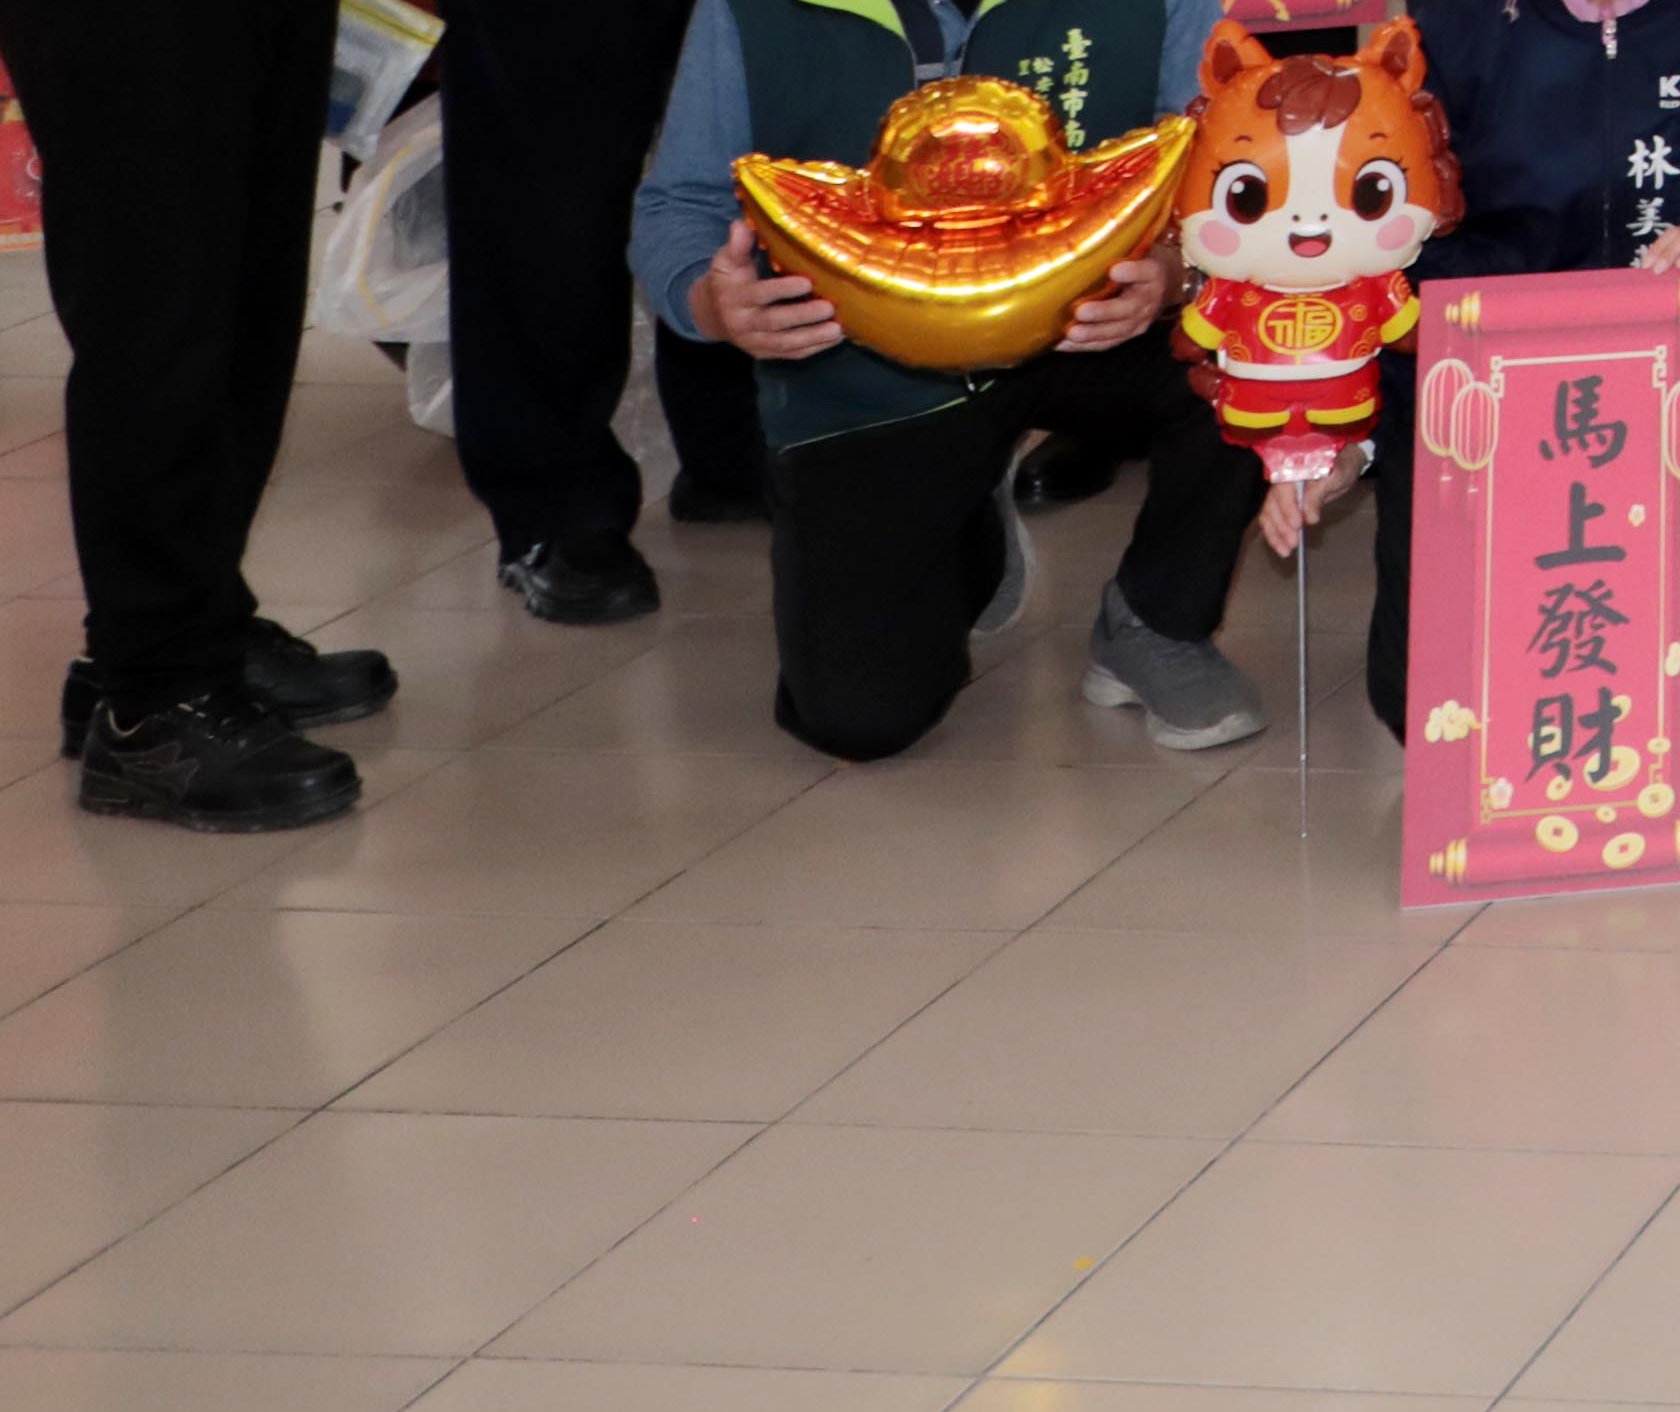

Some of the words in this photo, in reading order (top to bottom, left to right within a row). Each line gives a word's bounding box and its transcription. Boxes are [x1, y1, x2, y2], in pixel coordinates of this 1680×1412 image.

[1060, 27, 1093, 152] 臺南市南
[1526, 373, 1630, 786] 馬上發財
